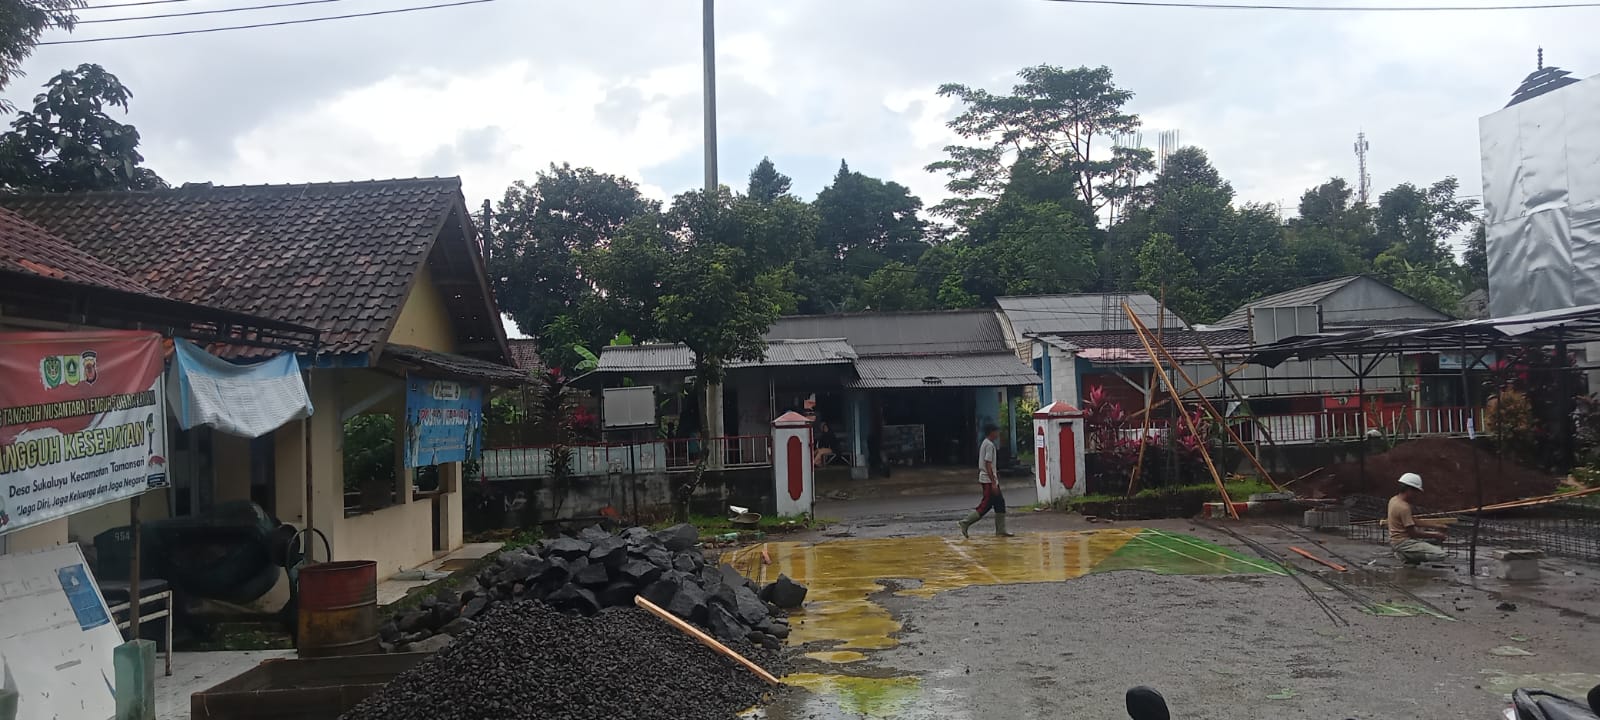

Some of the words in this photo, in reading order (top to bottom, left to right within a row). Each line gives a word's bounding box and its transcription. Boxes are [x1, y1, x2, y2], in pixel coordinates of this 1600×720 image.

[4, 404, 42, 426] TANGGUH
[43, 400, 86, 420] NUSANTARA
[63, 421, 145, 461] KESEHATAN
[9, 485, 31, 498] Desa
[33, 475, 68, 493] Sukaluyu
[70, 466, 109, 483] Kecamatan
[110, 456, 145, 473] Tamansari
[52, 494, 68, 507] Jaga
[69, 487, 97, 502] Keluarga
[97, 483, 108, 494] dan
[108, 480, 123, 493] Jaga
